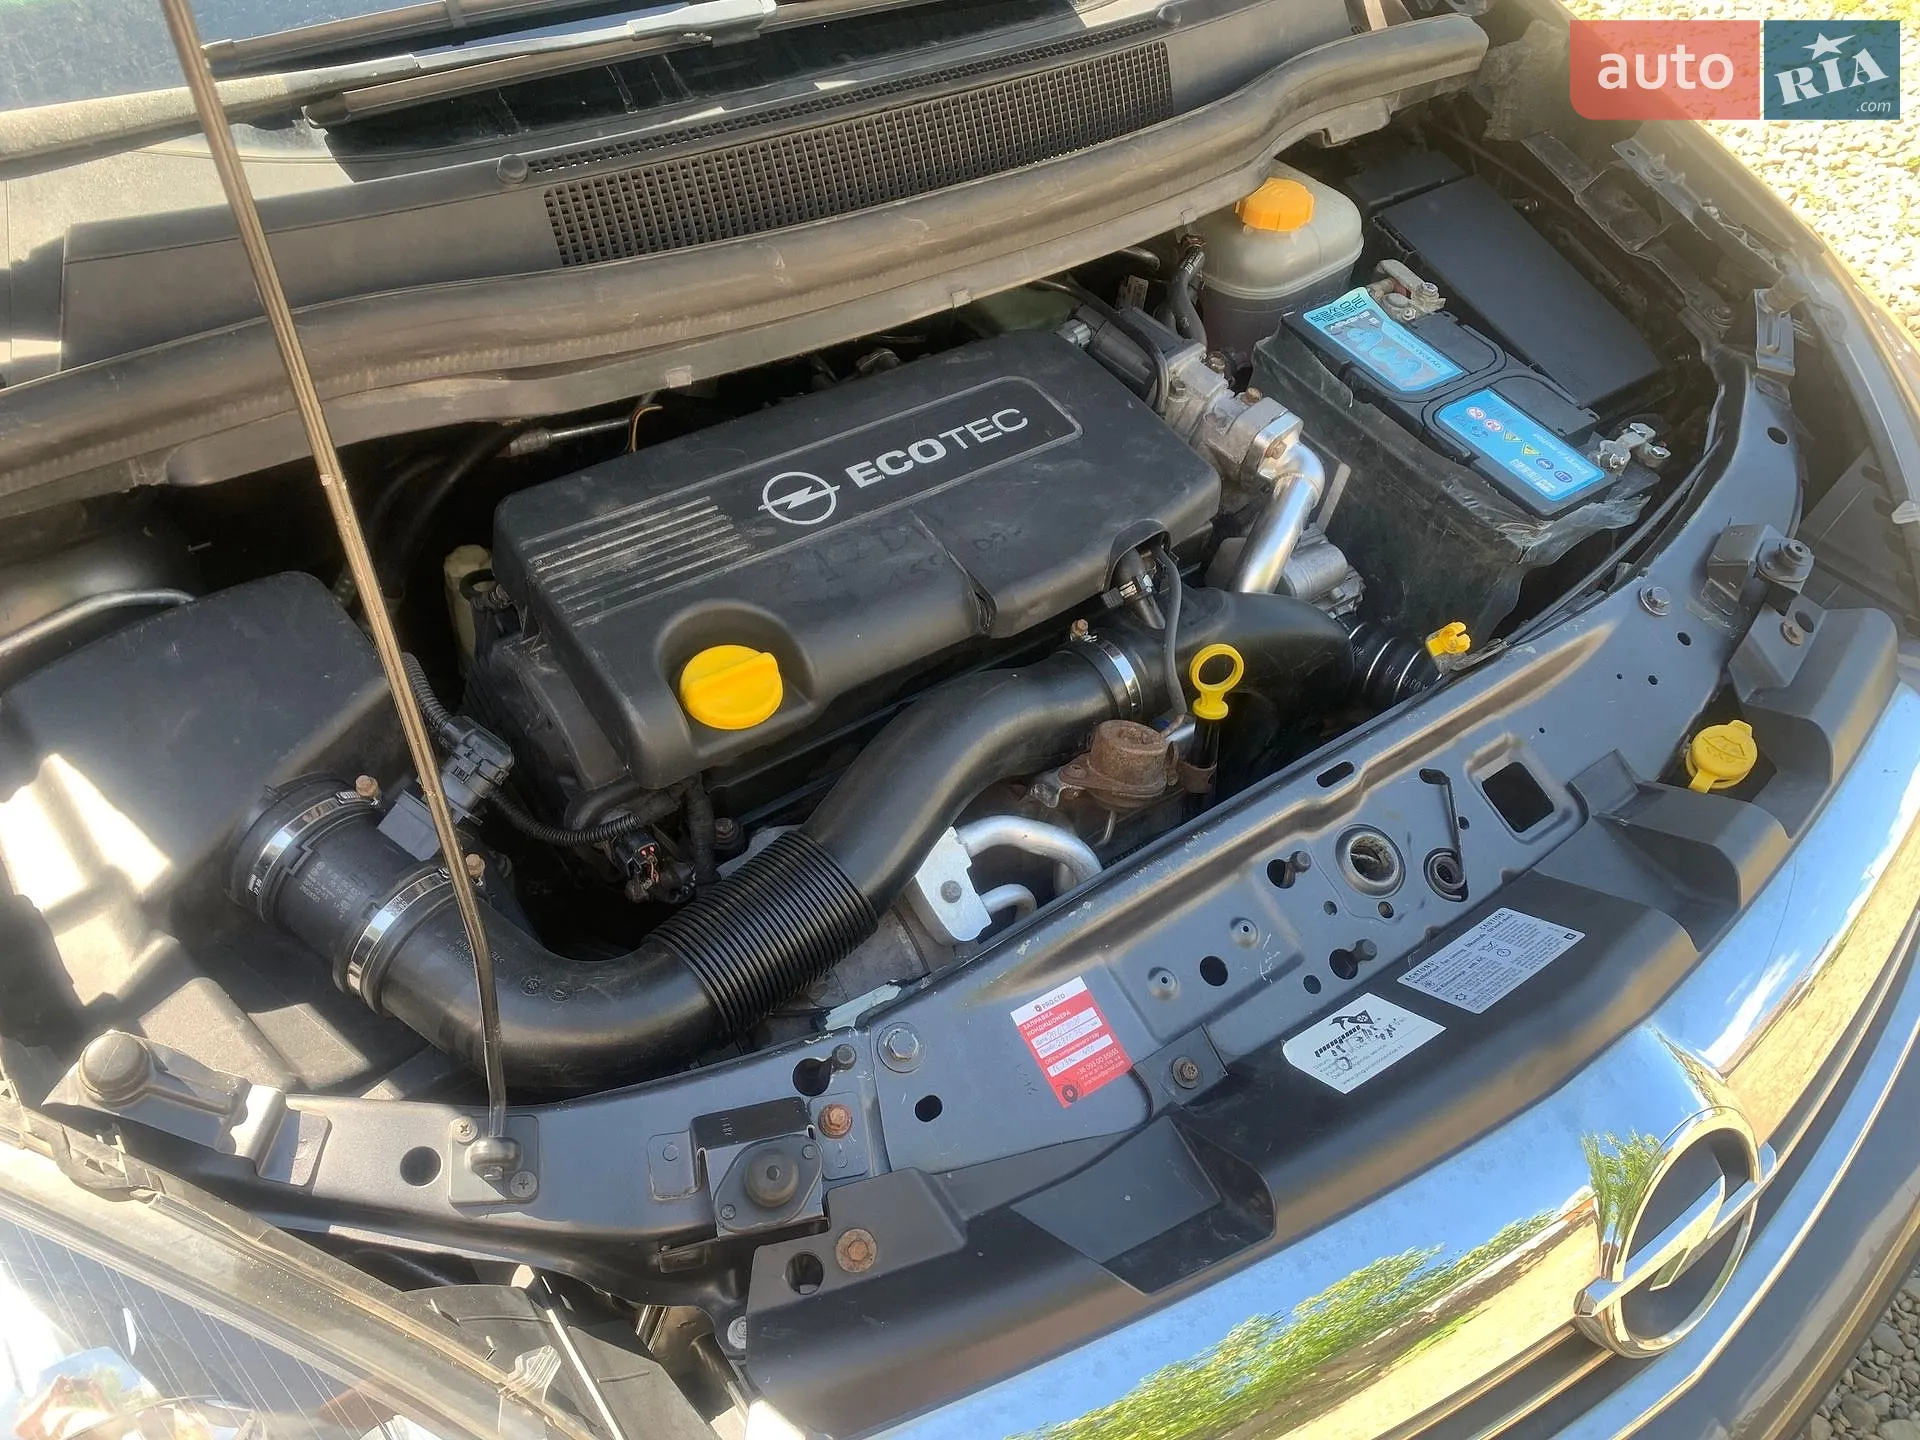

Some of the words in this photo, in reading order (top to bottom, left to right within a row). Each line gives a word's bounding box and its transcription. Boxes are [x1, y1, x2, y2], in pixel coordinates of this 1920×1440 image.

[845, 408, 1028, 488] ECOTEC
[1404, 960, 1436, 982] ACHTUNG!
[1022, 1011, 1054, 1031] ЗАПРАВКА
[1027, 1010, 1071, 1037] КОНДИЦІОНЕРА
